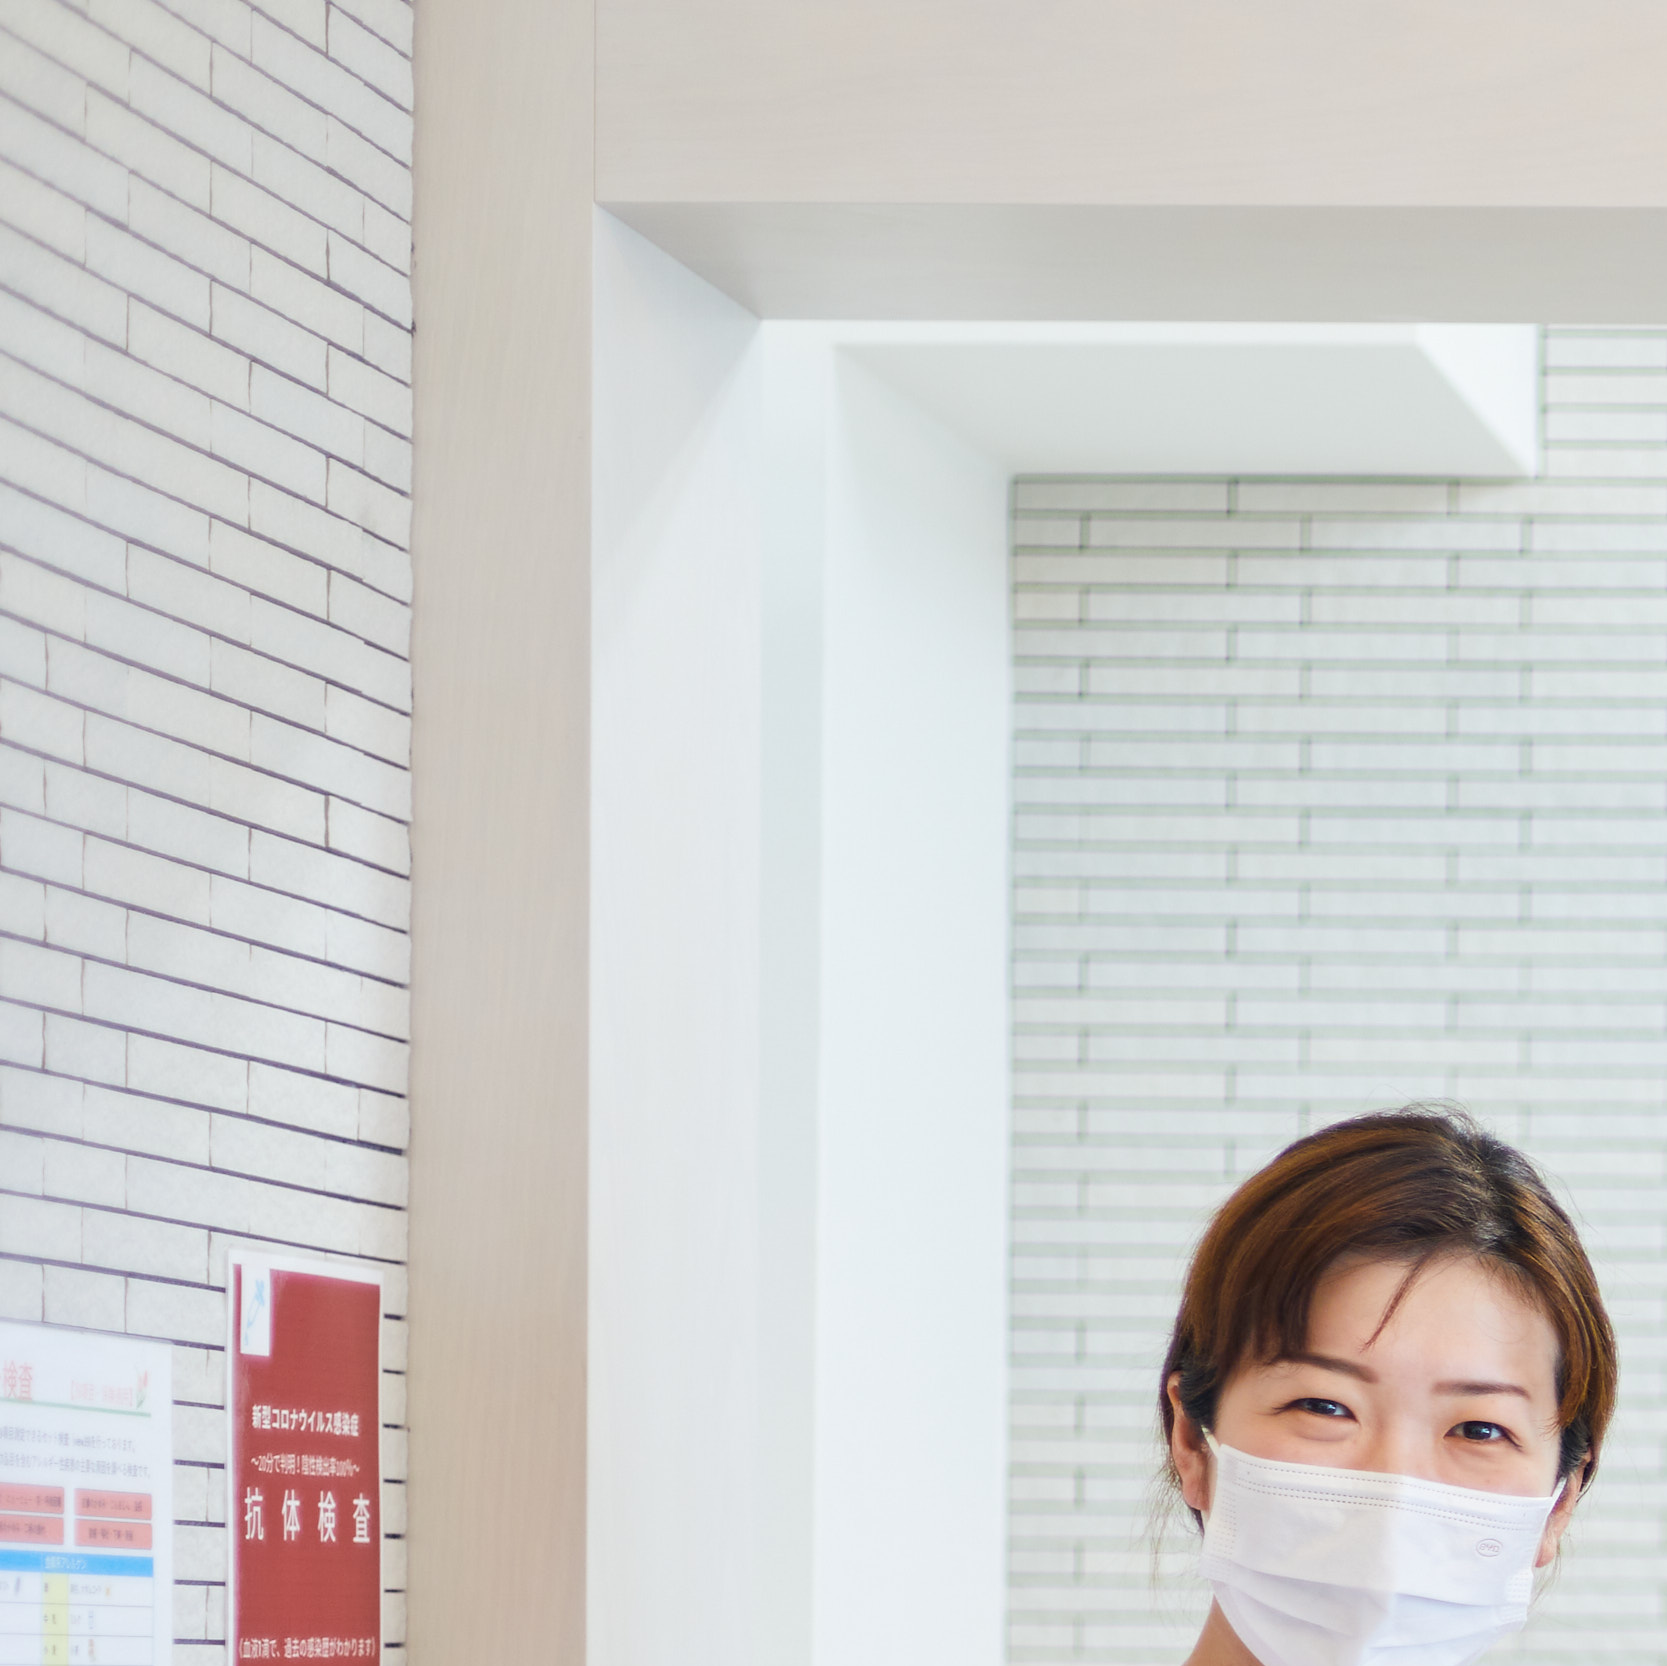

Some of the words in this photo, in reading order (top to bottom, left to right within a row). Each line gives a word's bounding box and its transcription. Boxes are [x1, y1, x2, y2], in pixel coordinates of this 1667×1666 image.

[252, 1404, 360, 1437] 新型コロナウイルス感染症
[244, 1486, 371, 1544] 抗体検査
